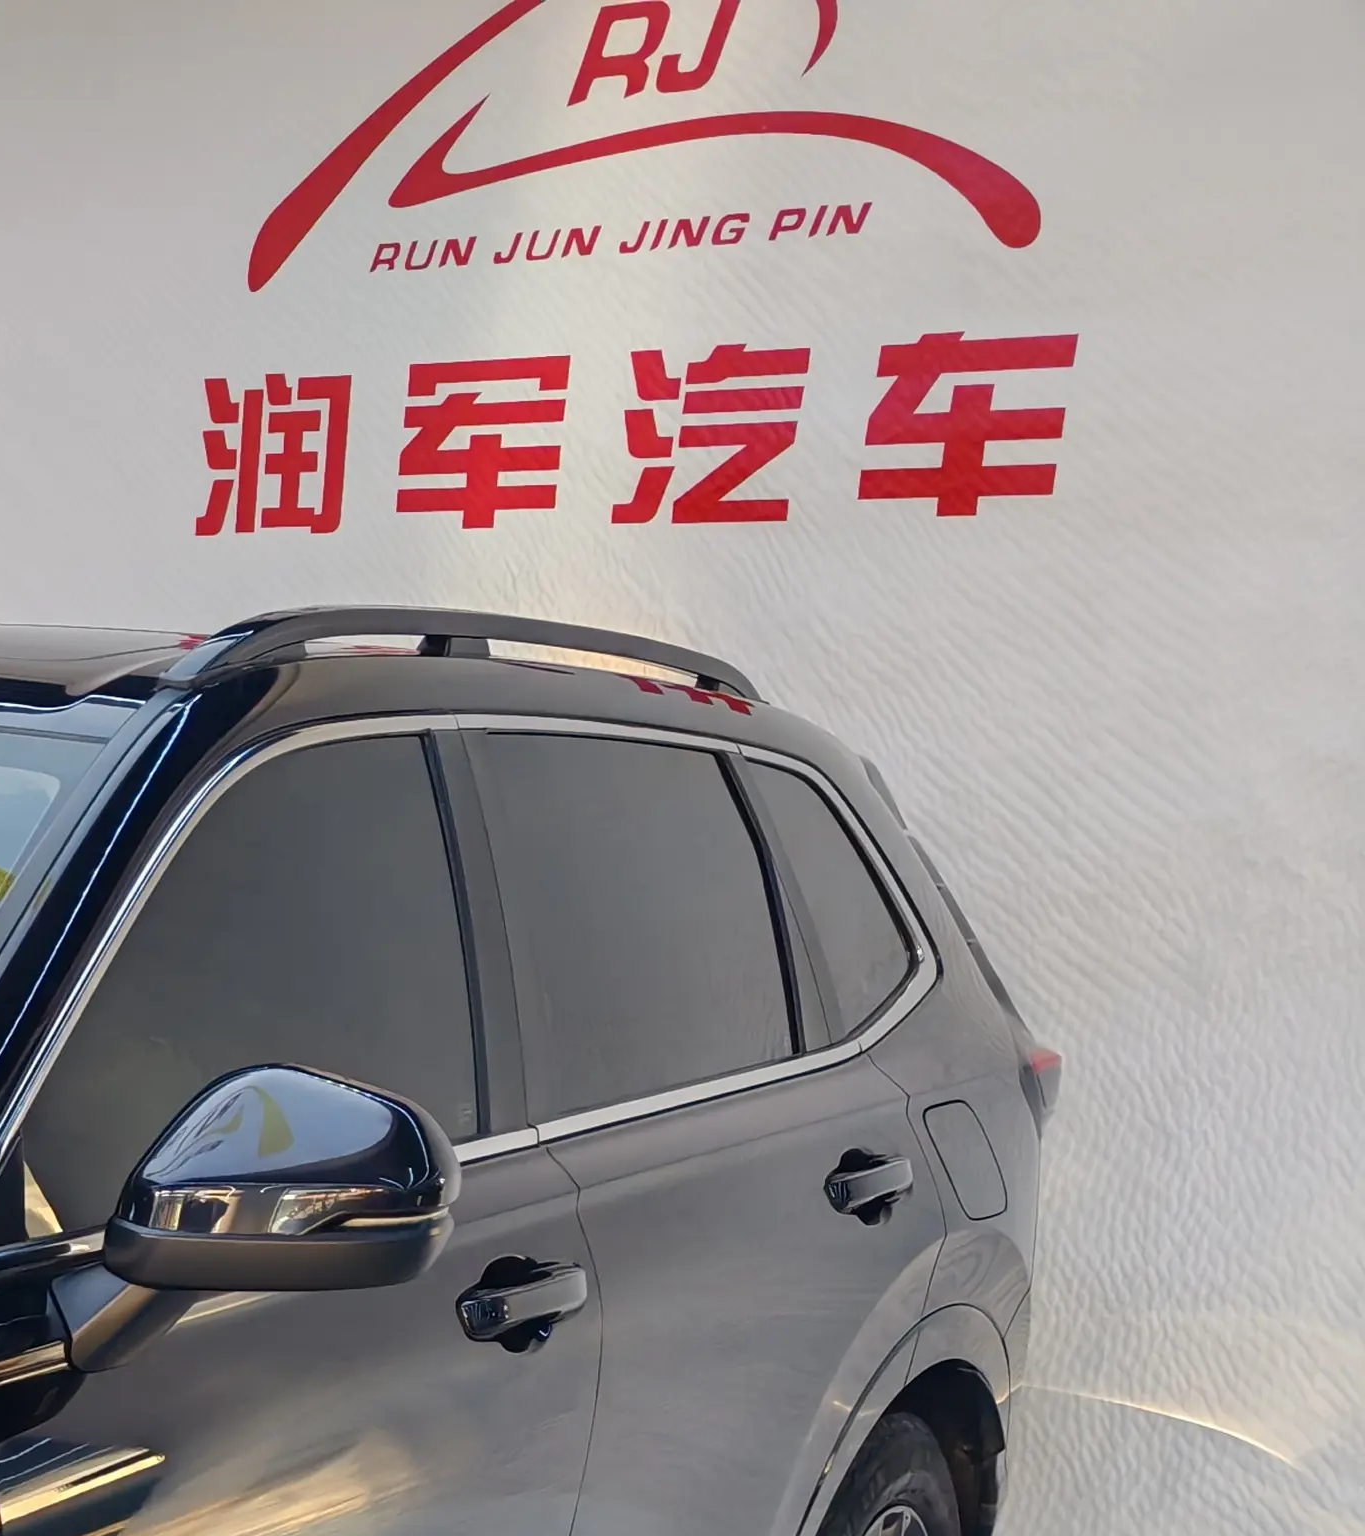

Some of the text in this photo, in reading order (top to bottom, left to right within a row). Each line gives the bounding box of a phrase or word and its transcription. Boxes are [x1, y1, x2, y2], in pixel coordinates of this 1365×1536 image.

[565, 0, 739, 107] RJ
[370, 201, 872, 273] RUN JUN JING PIN
[194, 331, 1080, 537] 润军汽车
